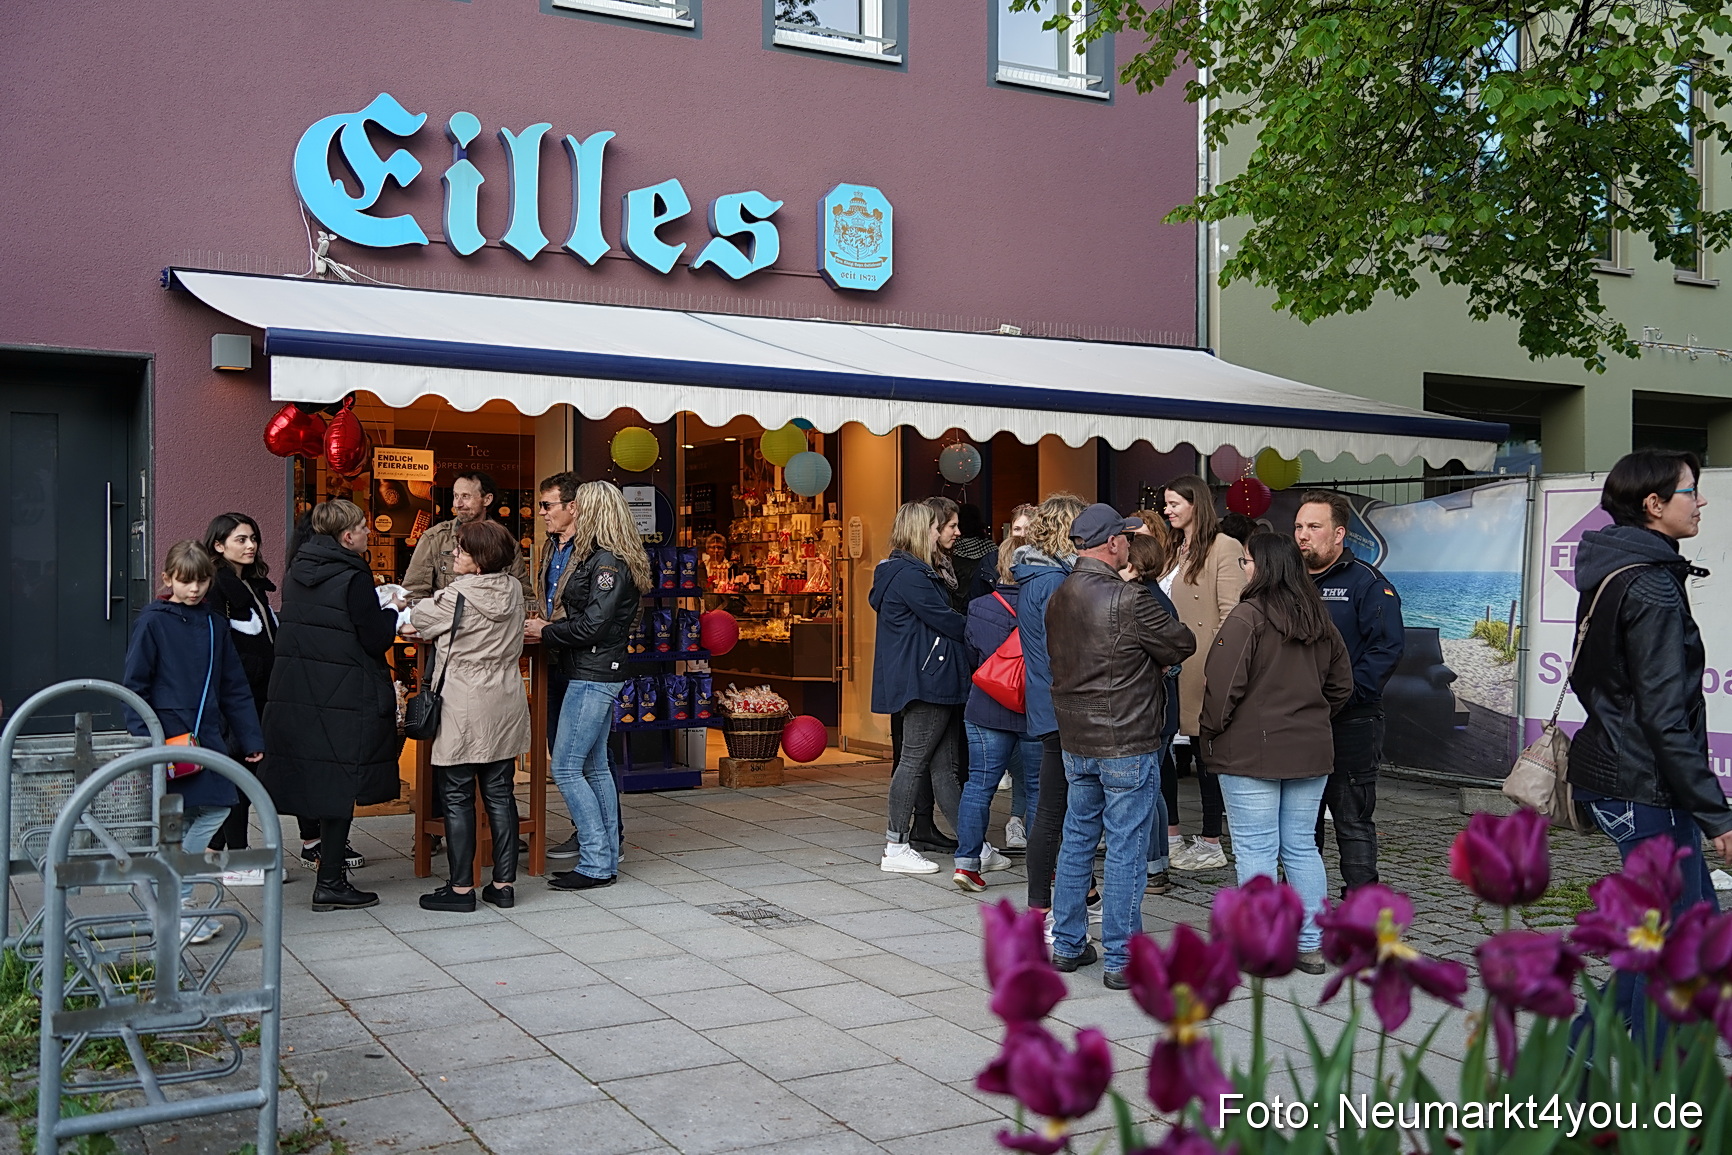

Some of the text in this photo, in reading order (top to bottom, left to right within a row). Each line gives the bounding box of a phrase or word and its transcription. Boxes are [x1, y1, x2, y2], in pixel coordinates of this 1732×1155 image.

[294, 92, 784, 280] Eilles
[840, 270, 877, 282] seit 1873
[467, 444, 490, 457] Tee
[377, 454, 413, 463] ENDLICH
[377, 462, 430, 471] FEIERABEND
[436, 460, 463, 469] ÖRPER
[470, 462, 494, 471] GEIST
[1362, 538, 1375, 547] MAYER
[1322, 588, 1348, 597] THW
